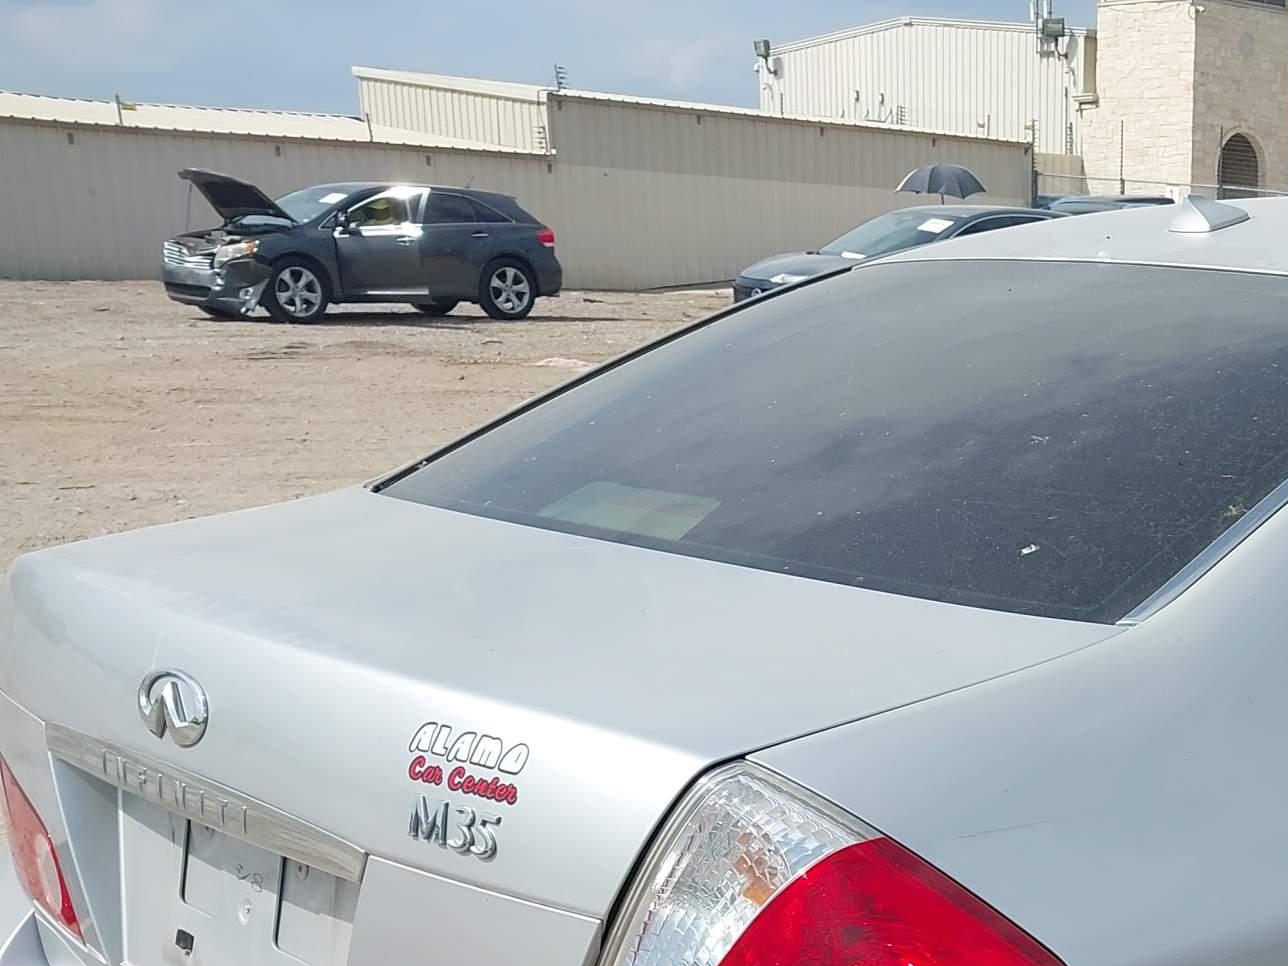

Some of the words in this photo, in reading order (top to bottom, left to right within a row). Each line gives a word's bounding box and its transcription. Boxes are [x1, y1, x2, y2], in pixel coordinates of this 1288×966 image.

[408, 721, 530, 776] ALAMO
[101, 748, 249, 835] INFINITI
[408, 755, 443, 786] Car
[447, 766, 518, 805] Center
[408, 795, 502, 862] M35
